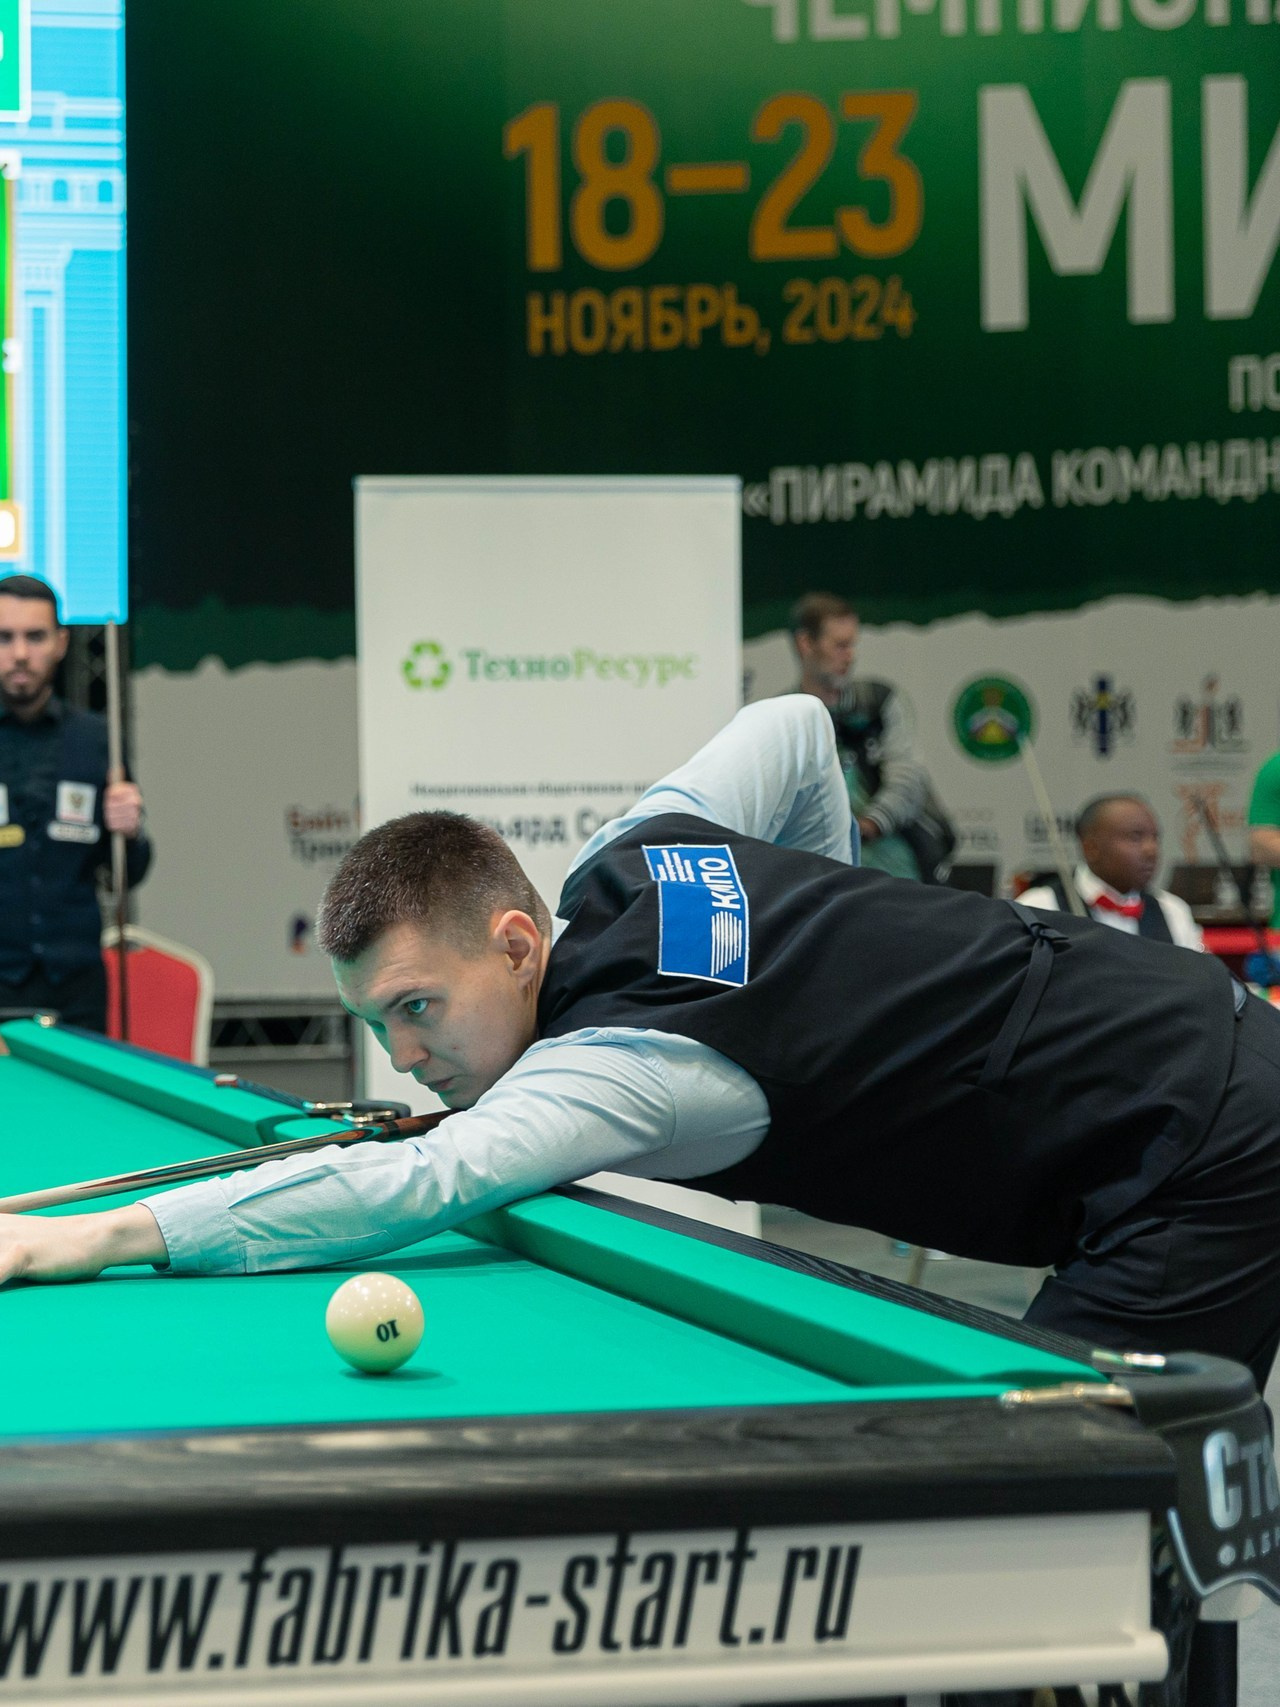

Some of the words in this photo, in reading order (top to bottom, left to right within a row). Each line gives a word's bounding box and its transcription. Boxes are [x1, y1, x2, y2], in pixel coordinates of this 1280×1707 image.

[526, 283, 771, 357] НОЯБРЬ,
[782, 276, 917, 345] 2024
[463, 649, 698, 688] ТехноРесурс
[376, 1319, 401, 1342] 10
